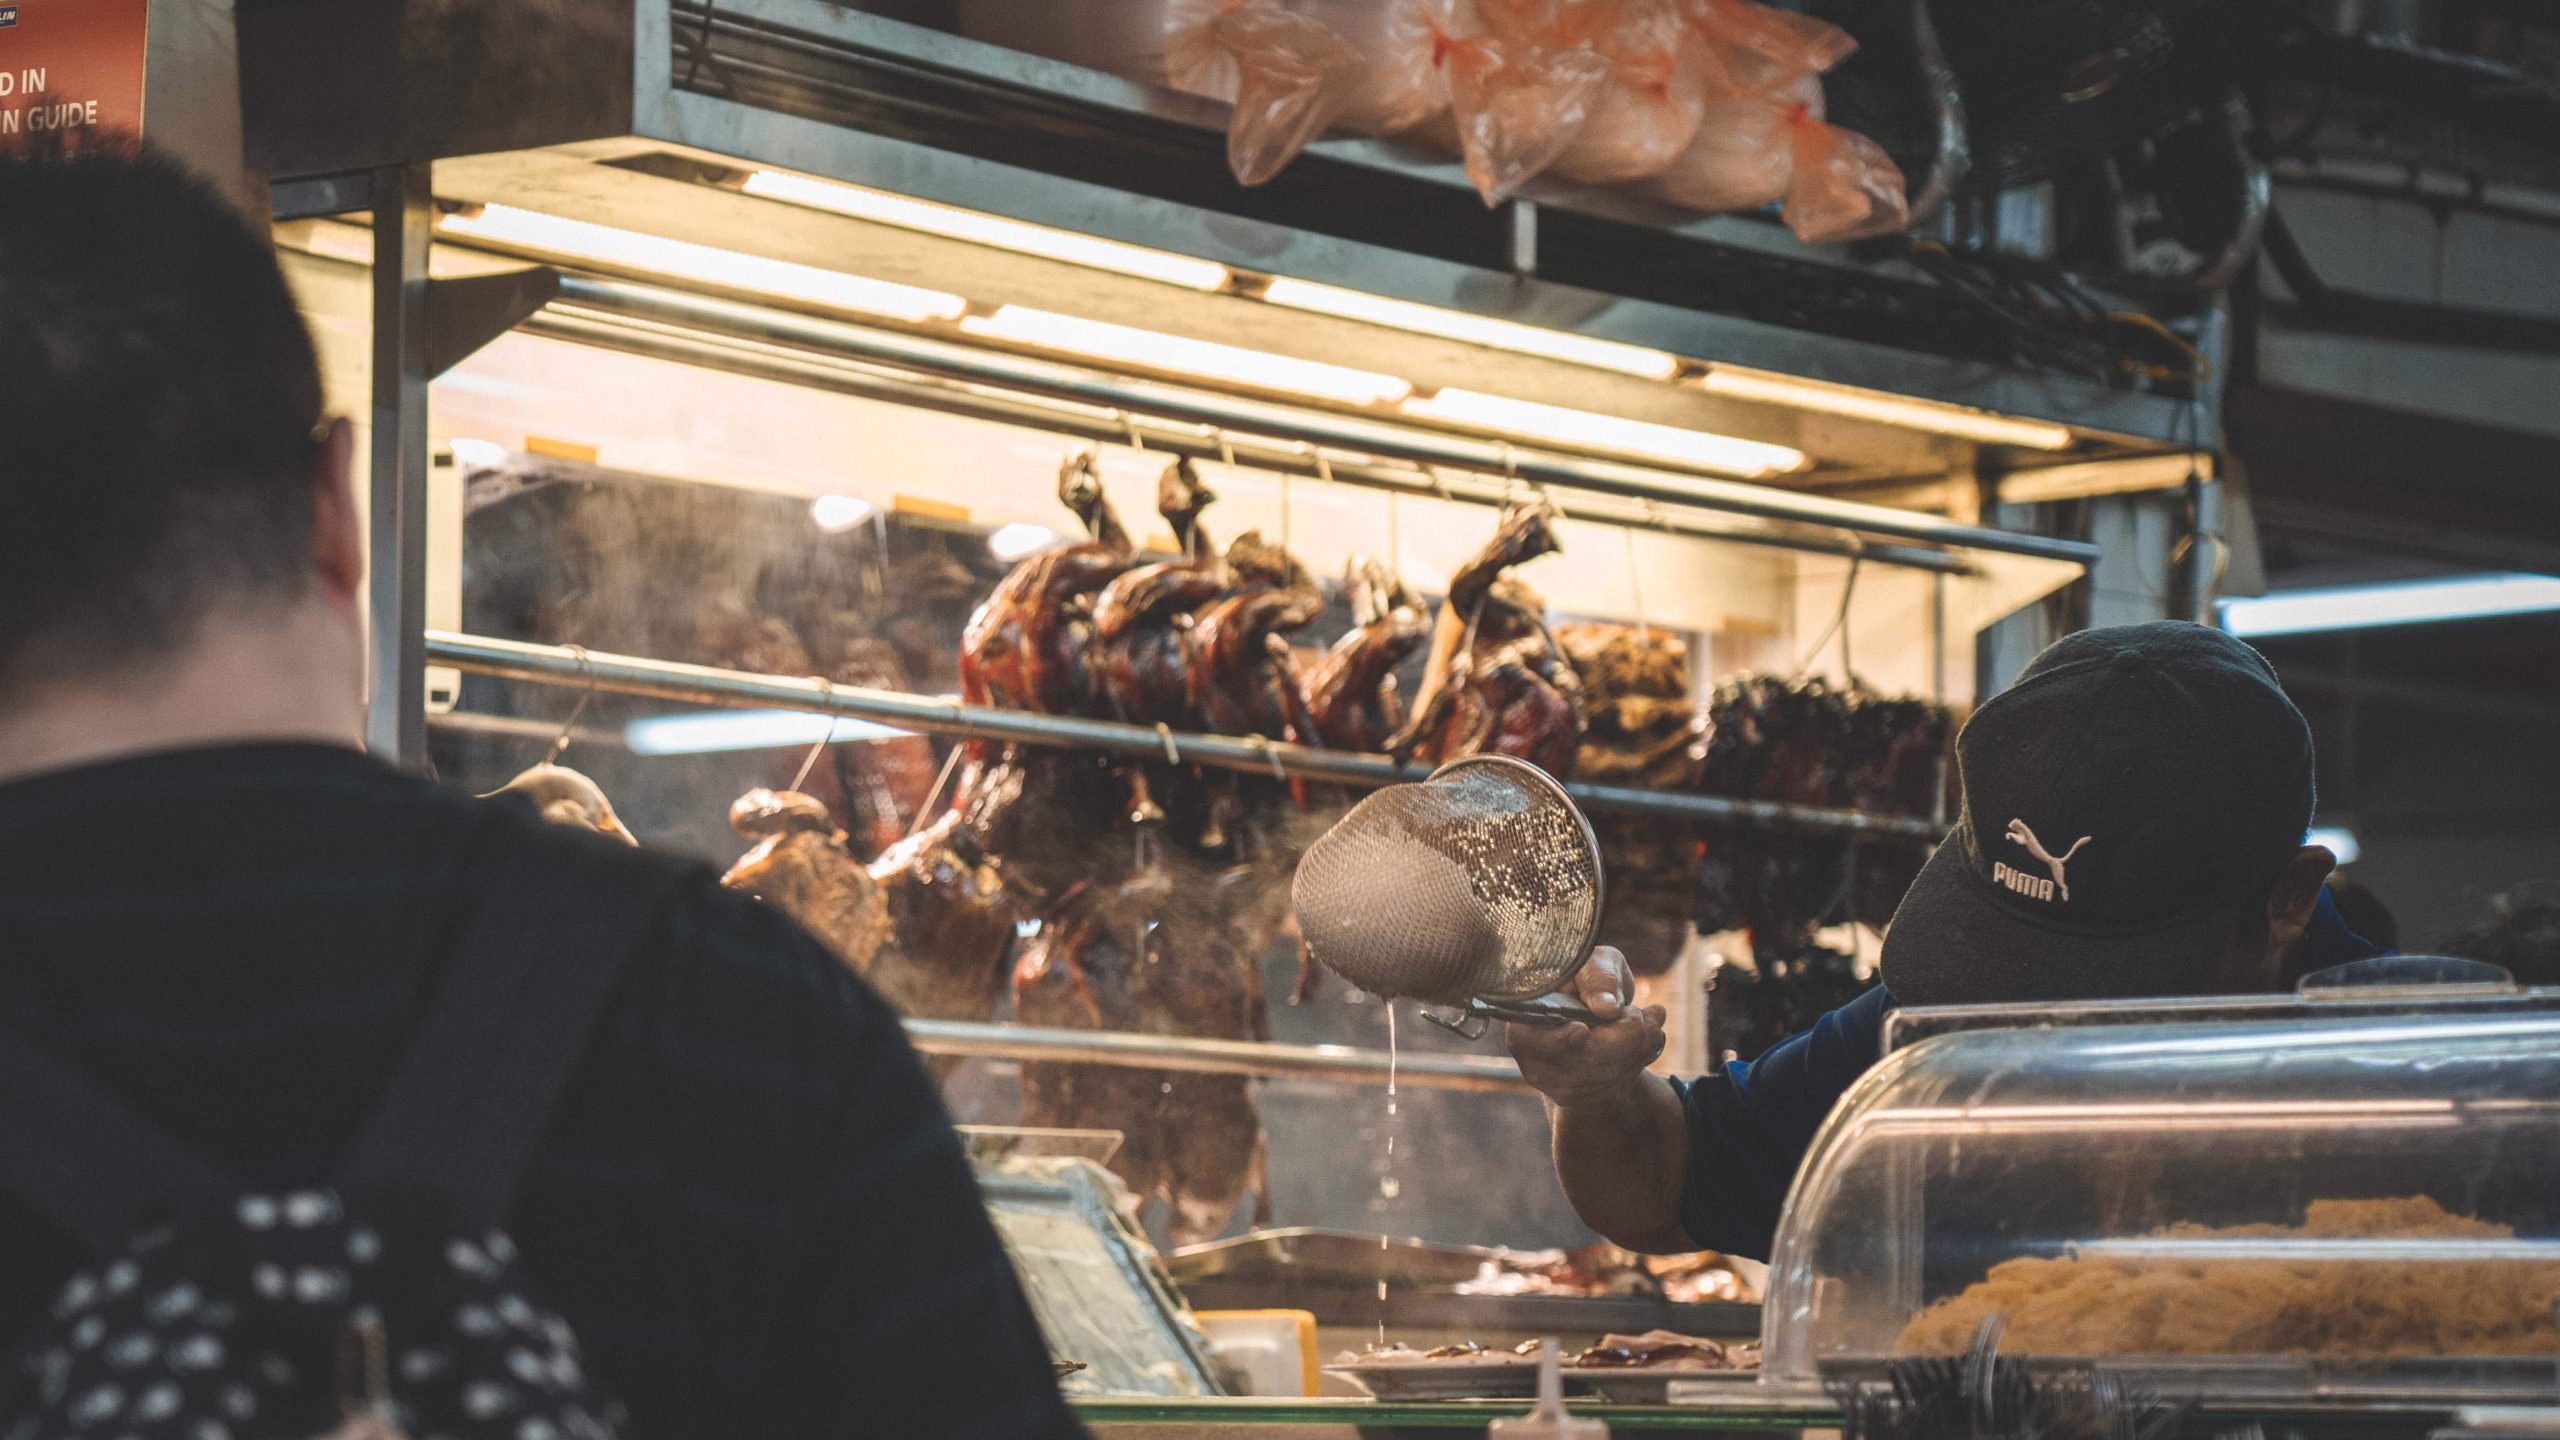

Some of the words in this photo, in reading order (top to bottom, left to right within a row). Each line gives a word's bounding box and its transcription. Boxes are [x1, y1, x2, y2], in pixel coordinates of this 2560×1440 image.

[21, 67, 46, 94] IN
[0, 109, 19, 134] N
[27, 100, 98, 131] GUIDE
[1993, 861, 2054, 902] PUMA
